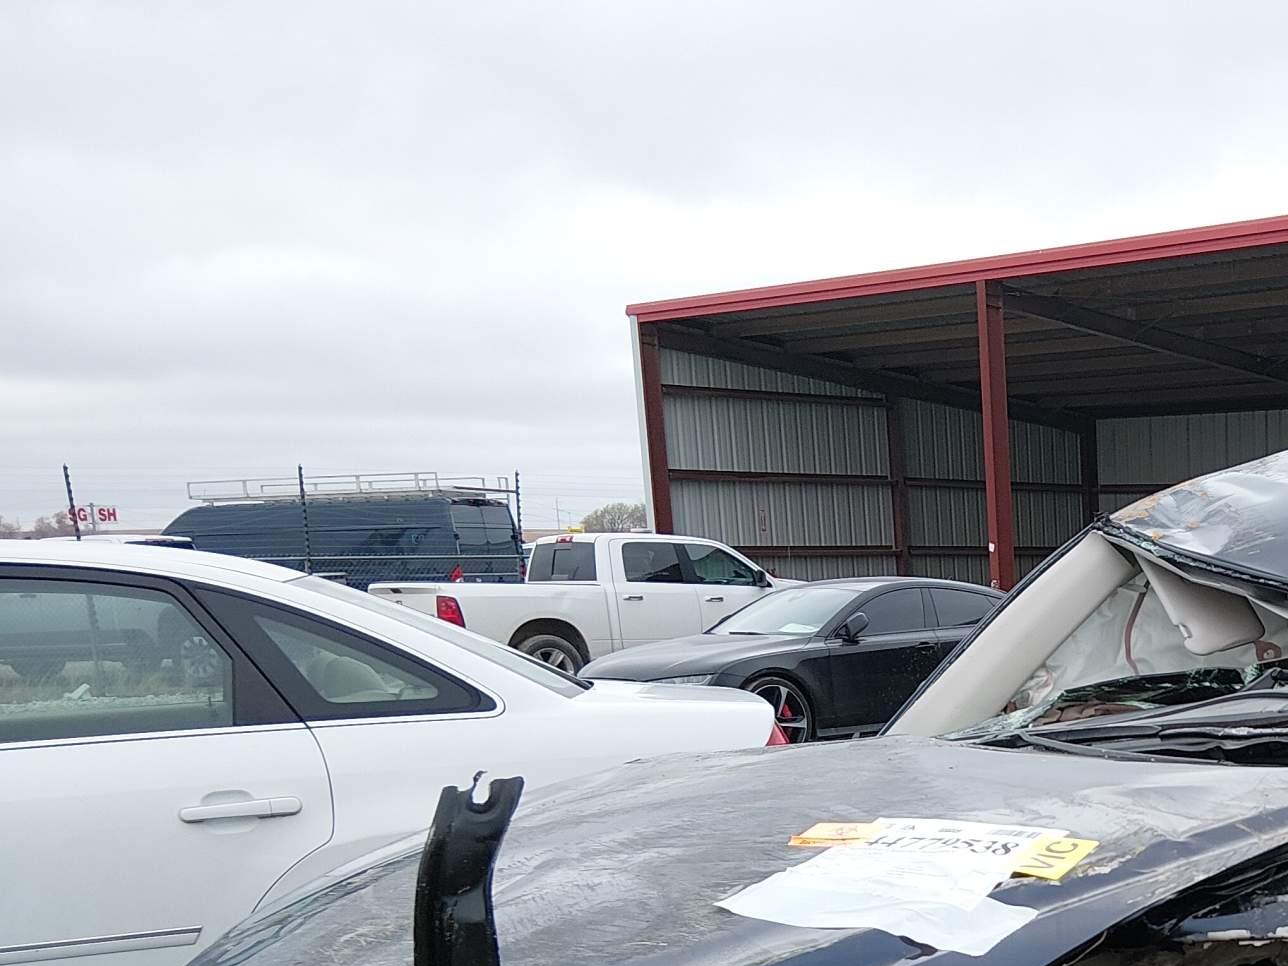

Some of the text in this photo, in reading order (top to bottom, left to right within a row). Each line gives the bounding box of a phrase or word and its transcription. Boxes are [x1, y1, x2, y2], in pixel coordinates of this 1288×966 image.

[98, 507, 118, 522] SH
[864, 835, 1020, 856] 44779538
[1018, 840, 1080, 869] VIC
